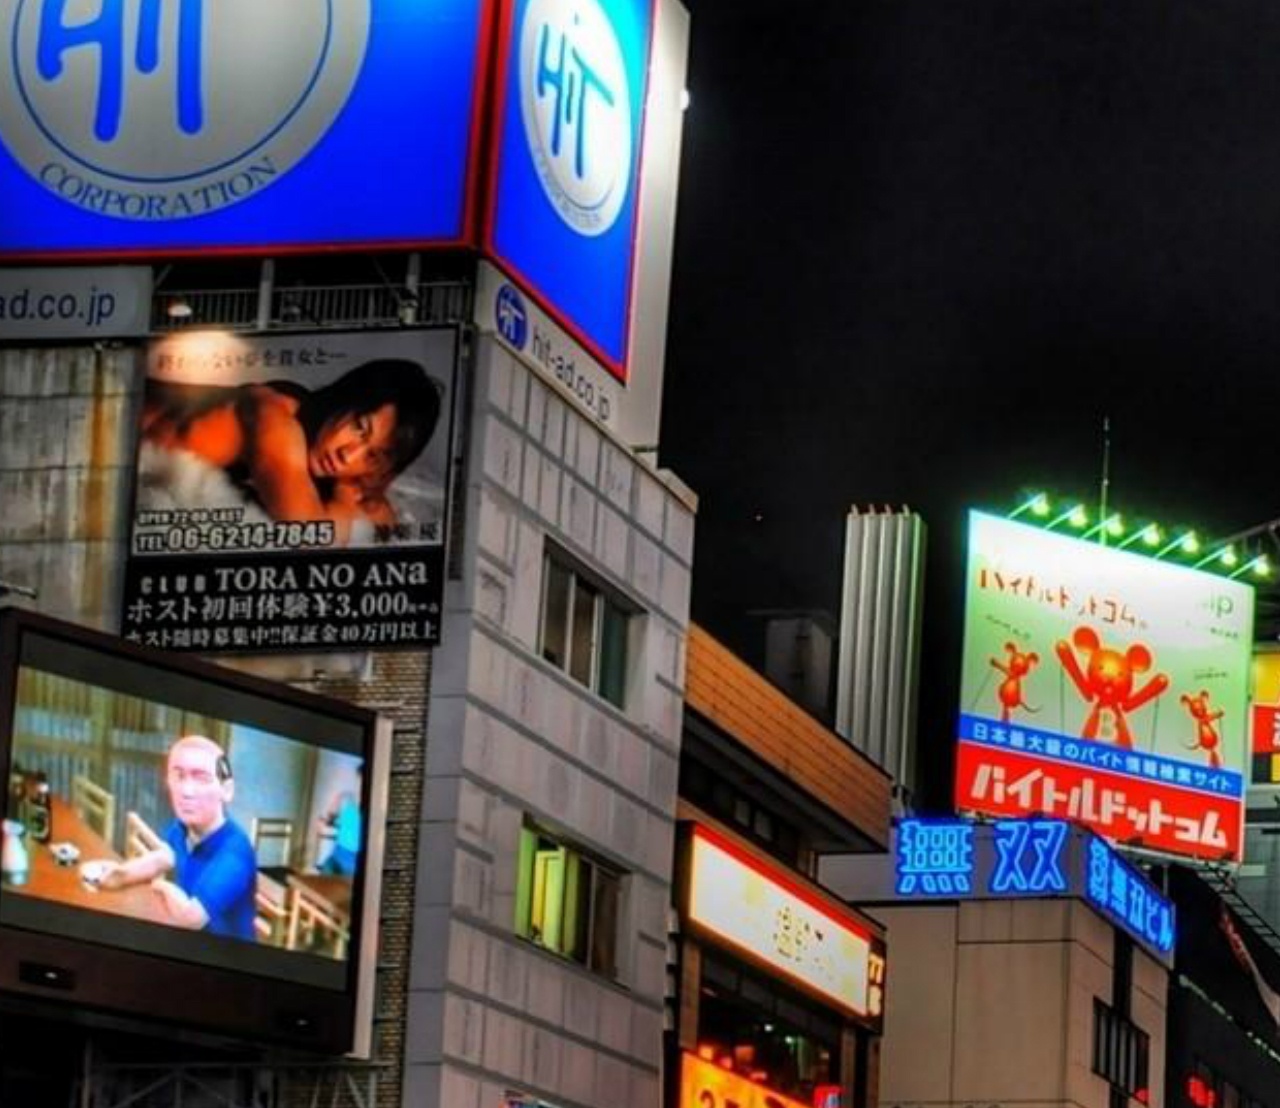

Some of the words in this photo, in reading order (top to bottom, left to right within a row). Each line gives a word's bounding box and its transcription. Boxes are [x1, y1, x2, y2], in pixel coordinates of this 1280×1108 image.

[38, 155, 280, 220] CORPORATION
[136, 533, 164, 550] TEL
[165, 522, 334, 549] 06-6214-7845
[140, 575, 208, 595] CLUB
[215, 566, 298, 592] TORA
[307, 564, 355, 588] NO
[971, 763, 1229, 849] バイトルドットコム
